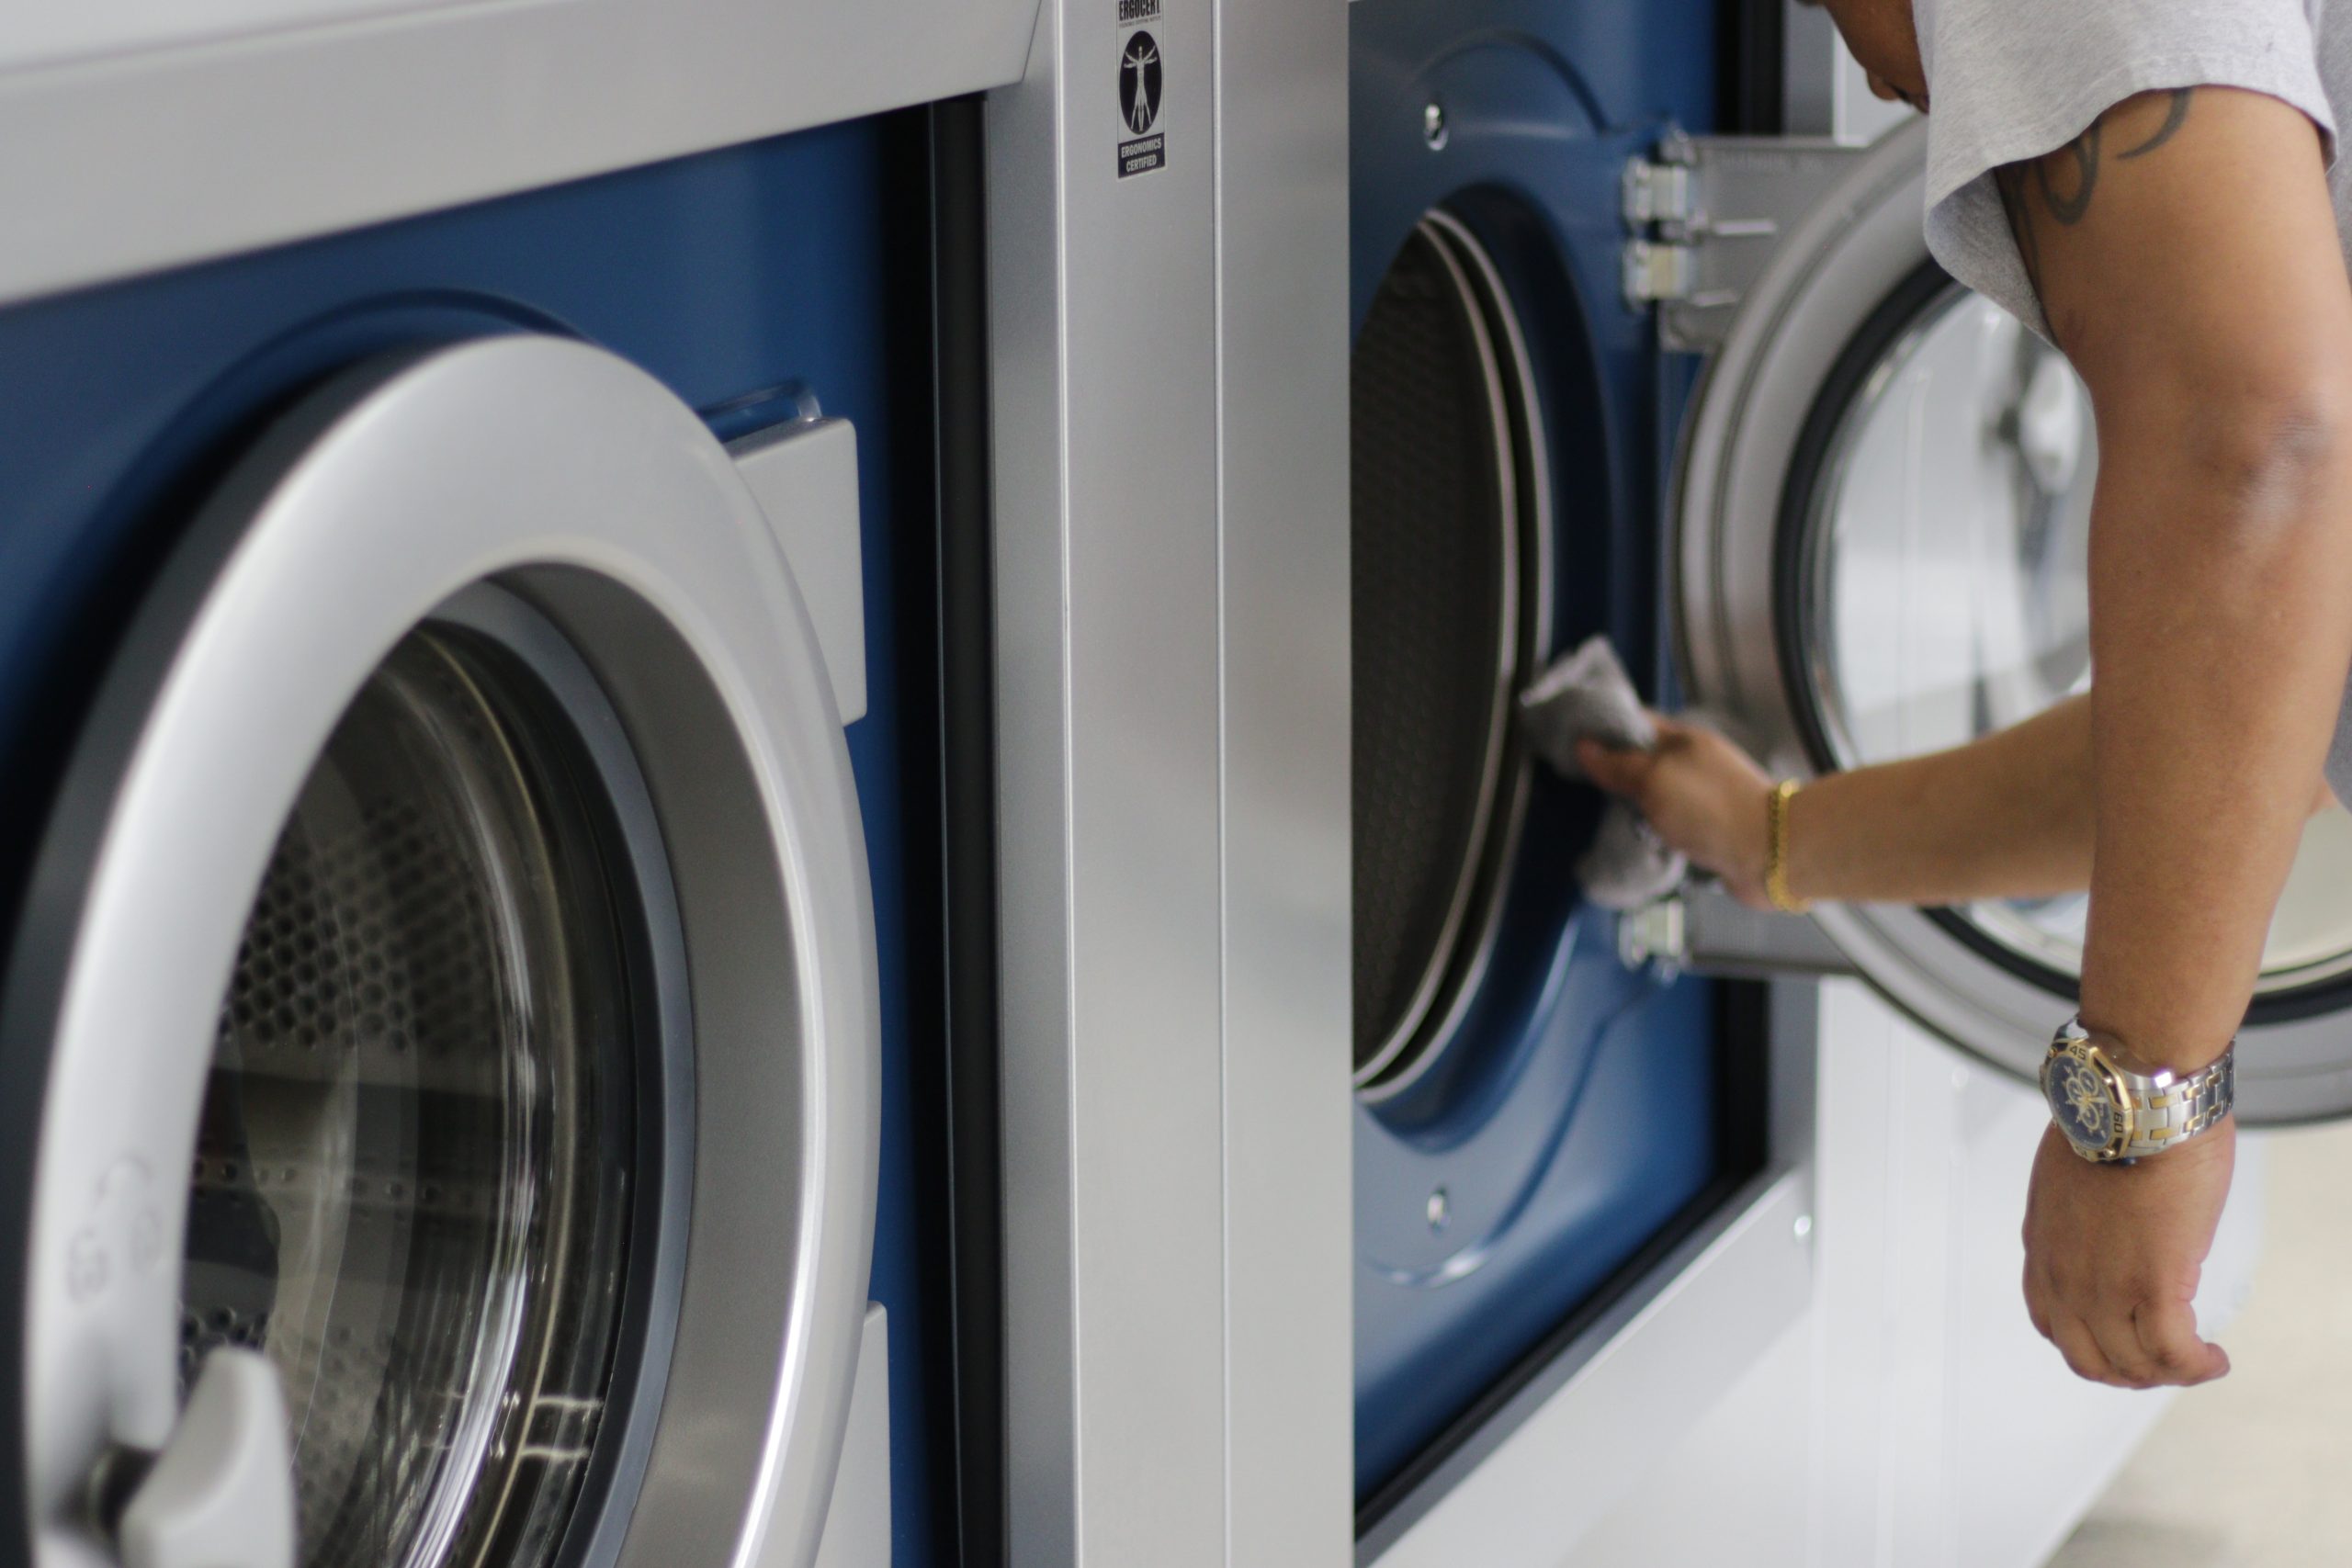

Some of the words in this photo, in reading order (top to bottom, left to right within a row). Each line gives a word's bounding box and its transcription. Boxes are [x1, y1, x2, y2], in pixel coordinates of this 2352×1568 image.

[1121, 138, 1161, 159] ERGONOMICS
[1126, 154, 1157, 173] CERTIFIED
[2069, 1045, 2086, 1060] 45
[2114, 1112, 2123, 1133] 60
